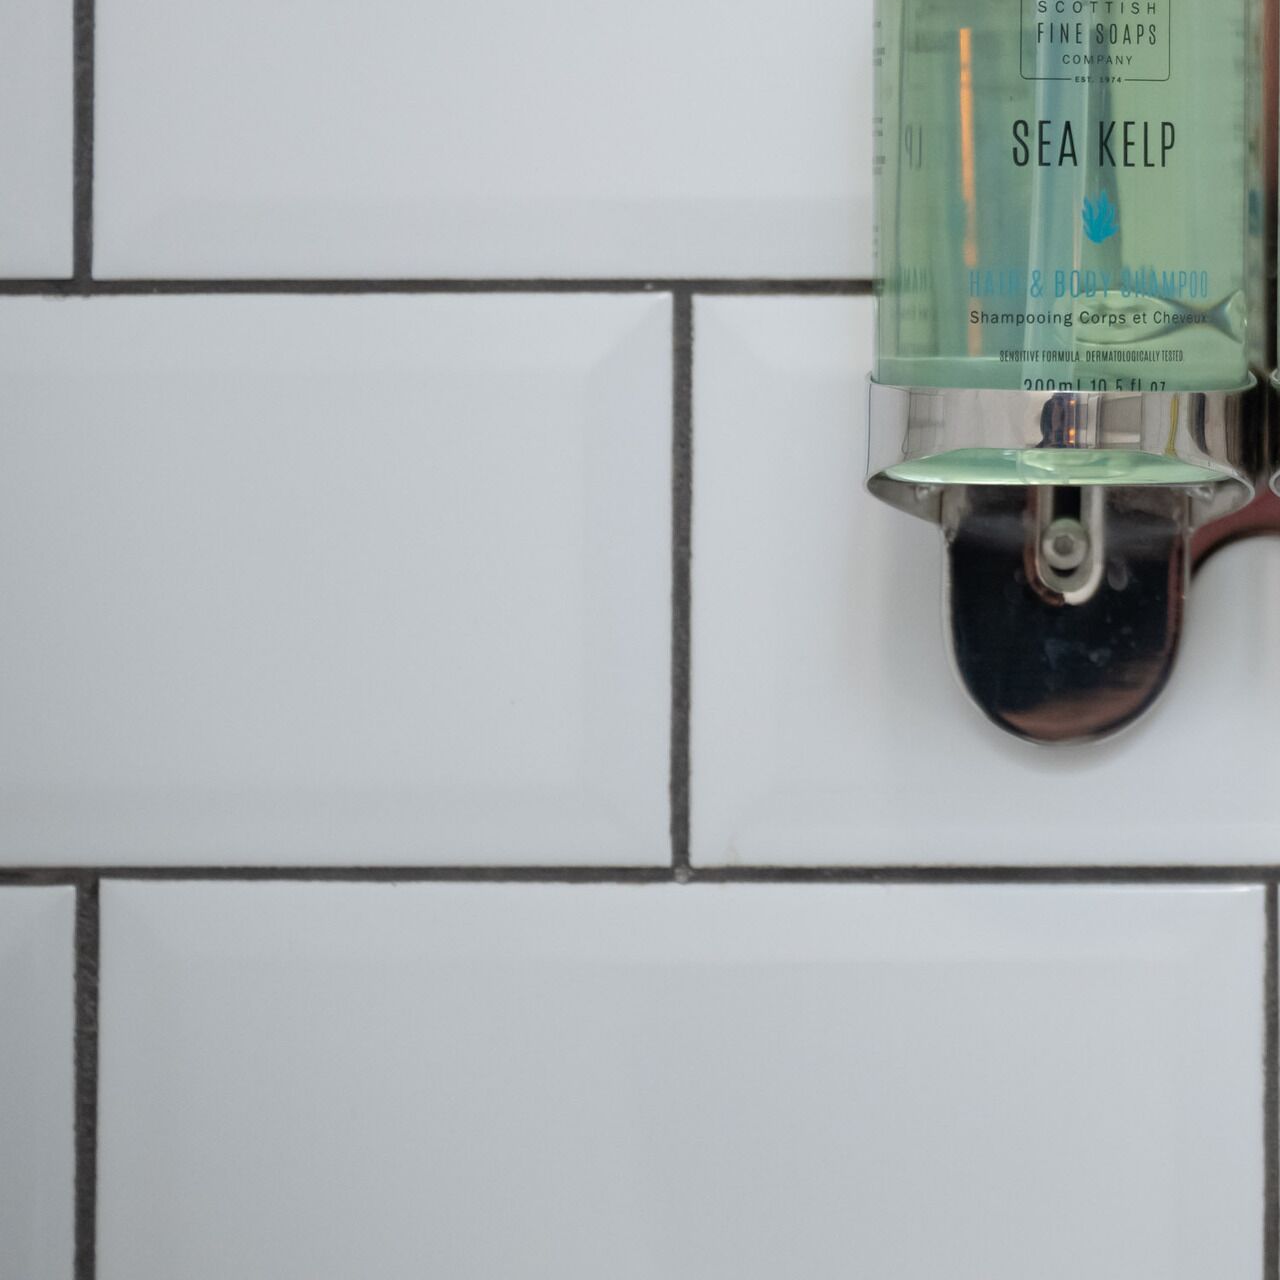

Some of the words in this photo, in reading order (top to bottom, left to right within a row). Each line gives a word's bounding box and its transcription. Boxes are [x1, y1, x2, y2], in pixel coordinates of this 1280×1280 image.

[1037, 0, 1156, 15] SCOTTISH
[1037, 22, 1083, 45] FINE
[1095, 23, 1157, 46] SOAPS
[1062, 54, 1133, 65] COMPANY
[1012, 119, 1078, 167] SEA
[1099, 120, 1176, 168] KELP
[1030, 269, 1044, 298] &
[1055, 269, 1112, 298] BODY
[1120, 269, 1208, 298] SHAMPOO
[969, 310, 1073, 327] Shampooing
[1079, 310, 1127, 327] Corps
[1132, 311, 1148, 325] et
[1000, 349, 1040, 363] SENSITIVE
[1086, 349, 1161, 363] DERMATOLOGICALLY
[1090, 378, 1123, 391] 105
